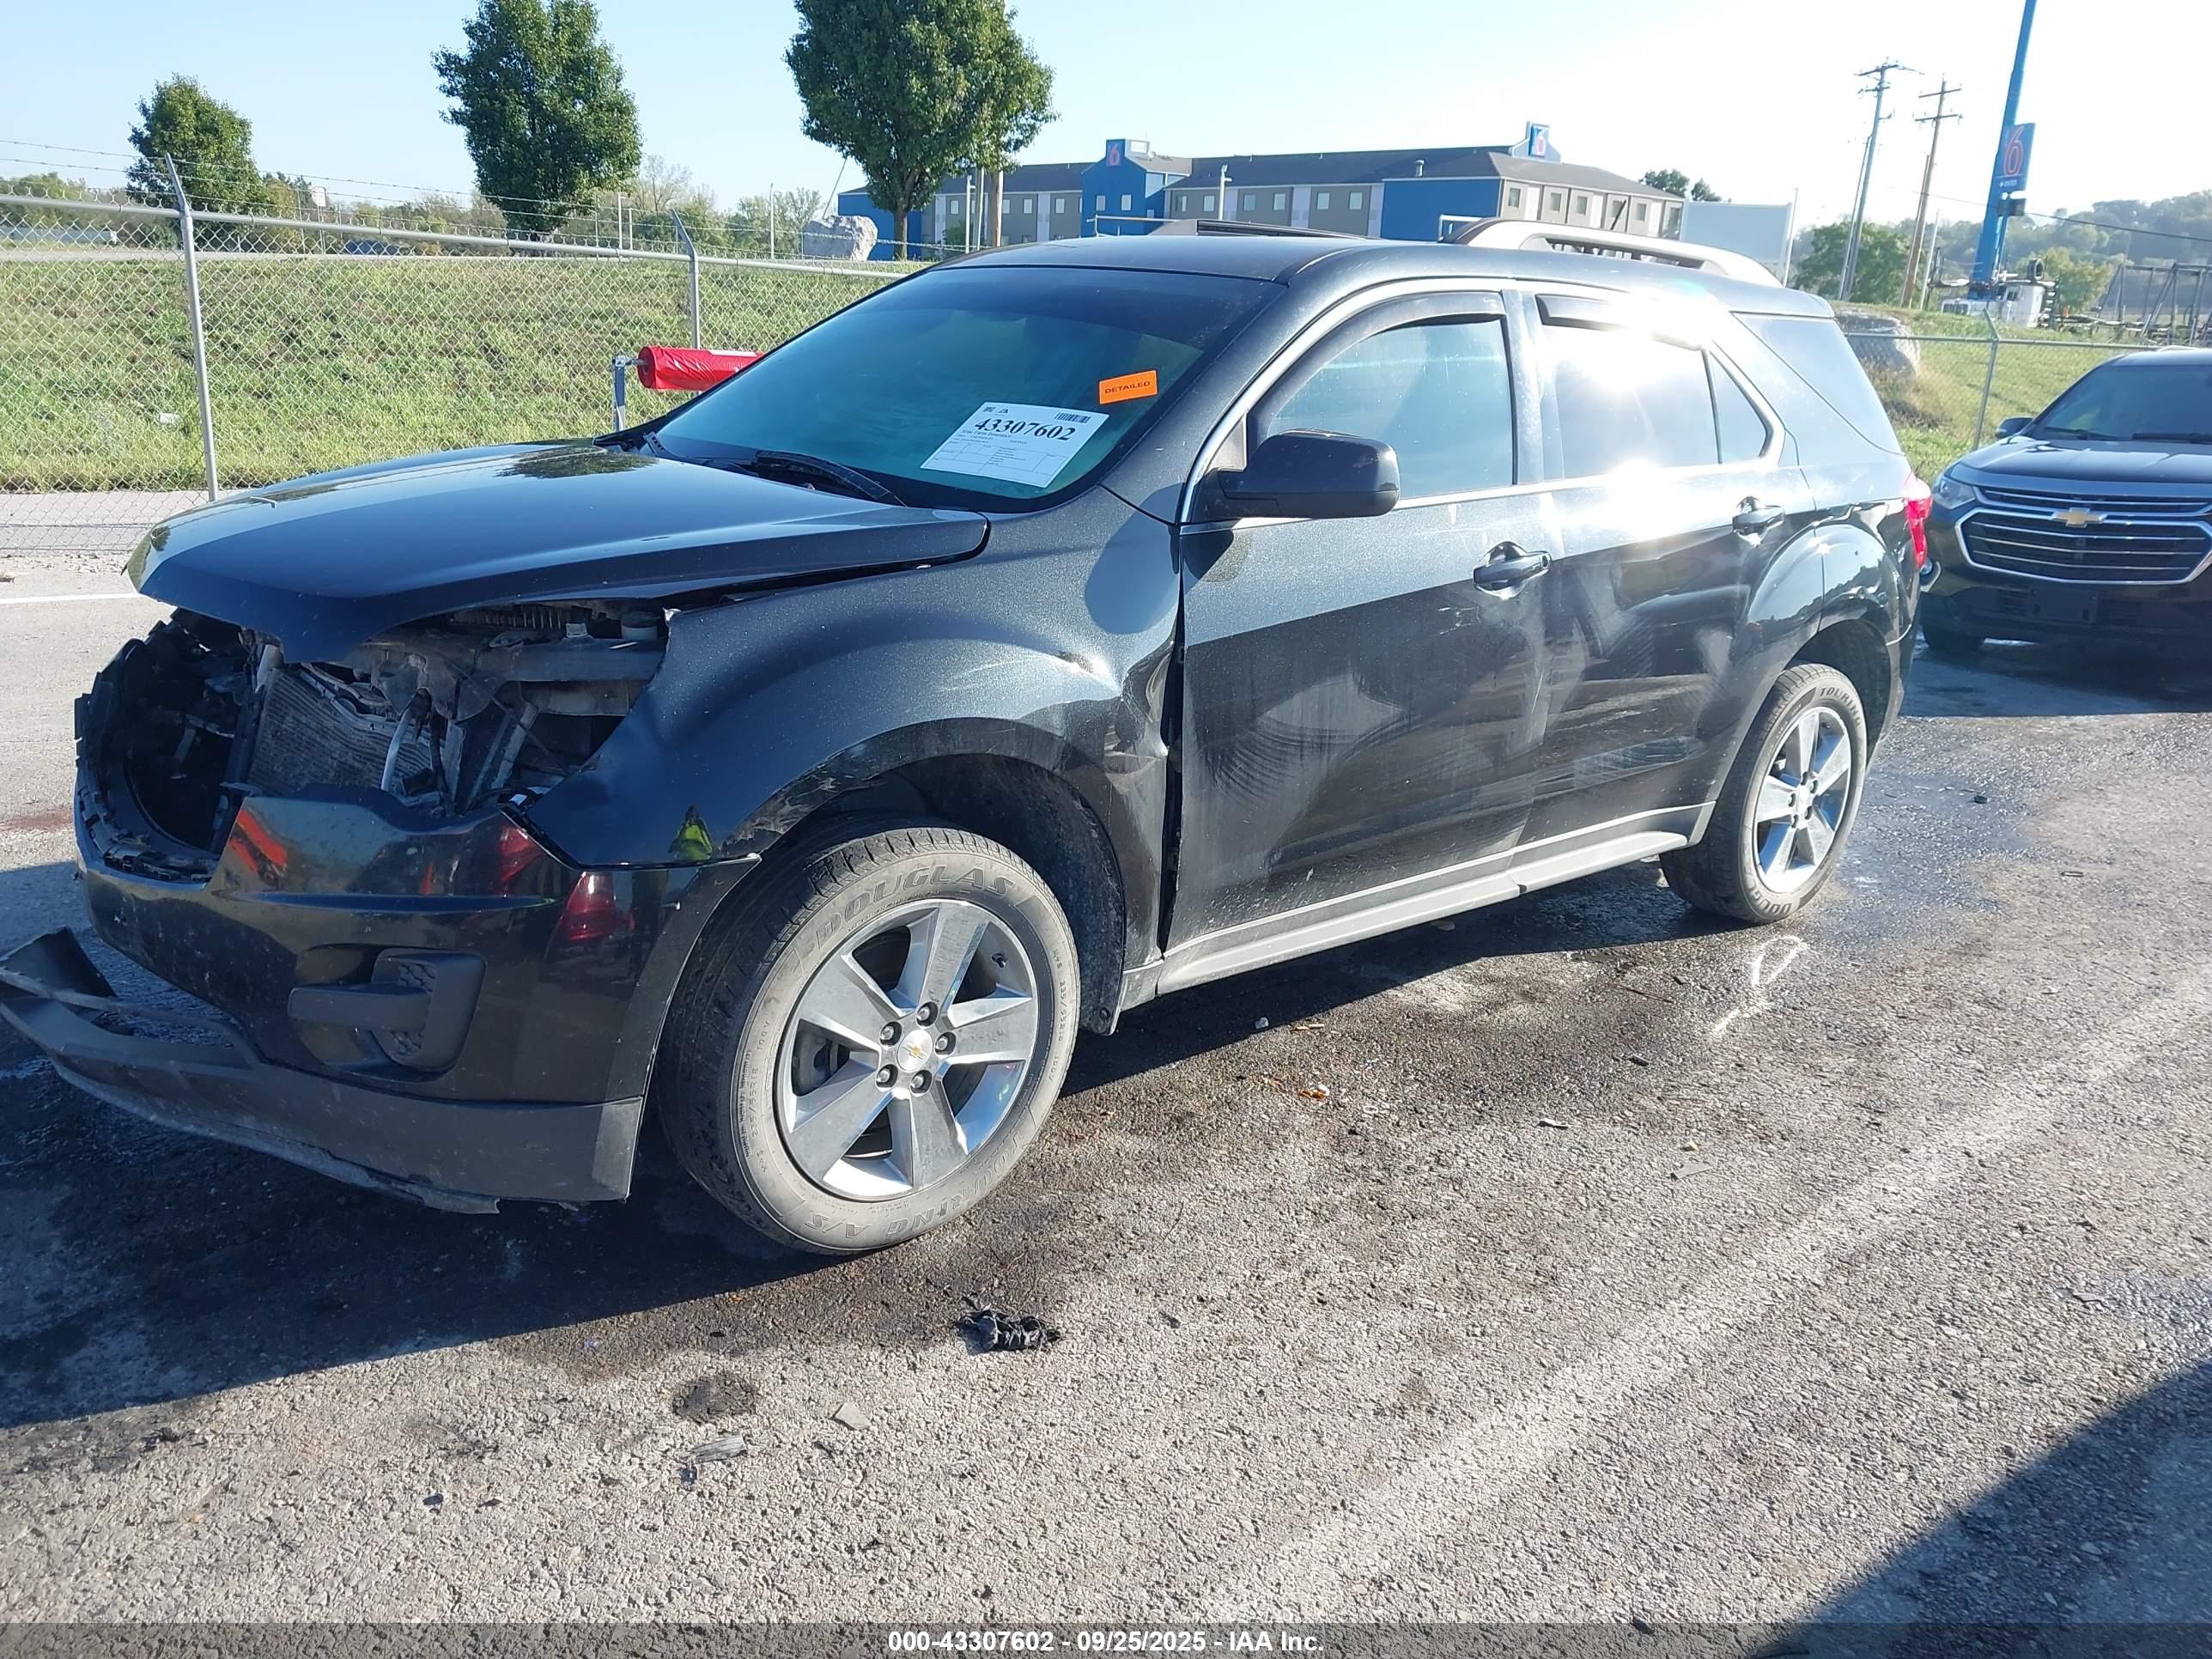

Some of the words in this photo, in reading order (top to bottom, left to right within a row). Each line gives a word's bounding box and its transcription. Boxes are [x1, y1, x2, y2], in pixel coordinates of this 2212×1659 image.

[1109, 143, 1121, 166] 6
[2004, 125, 2024, 176] 6
[1105, 380, 1151, 393] DETAILED
[975, 417, 1076, 441] 43307602
[816, 865, 1014, 951] DOUGLAS
[885, 1131, 1025, 1237] TOURING
[805, 1214, 871, 1239] A/S
